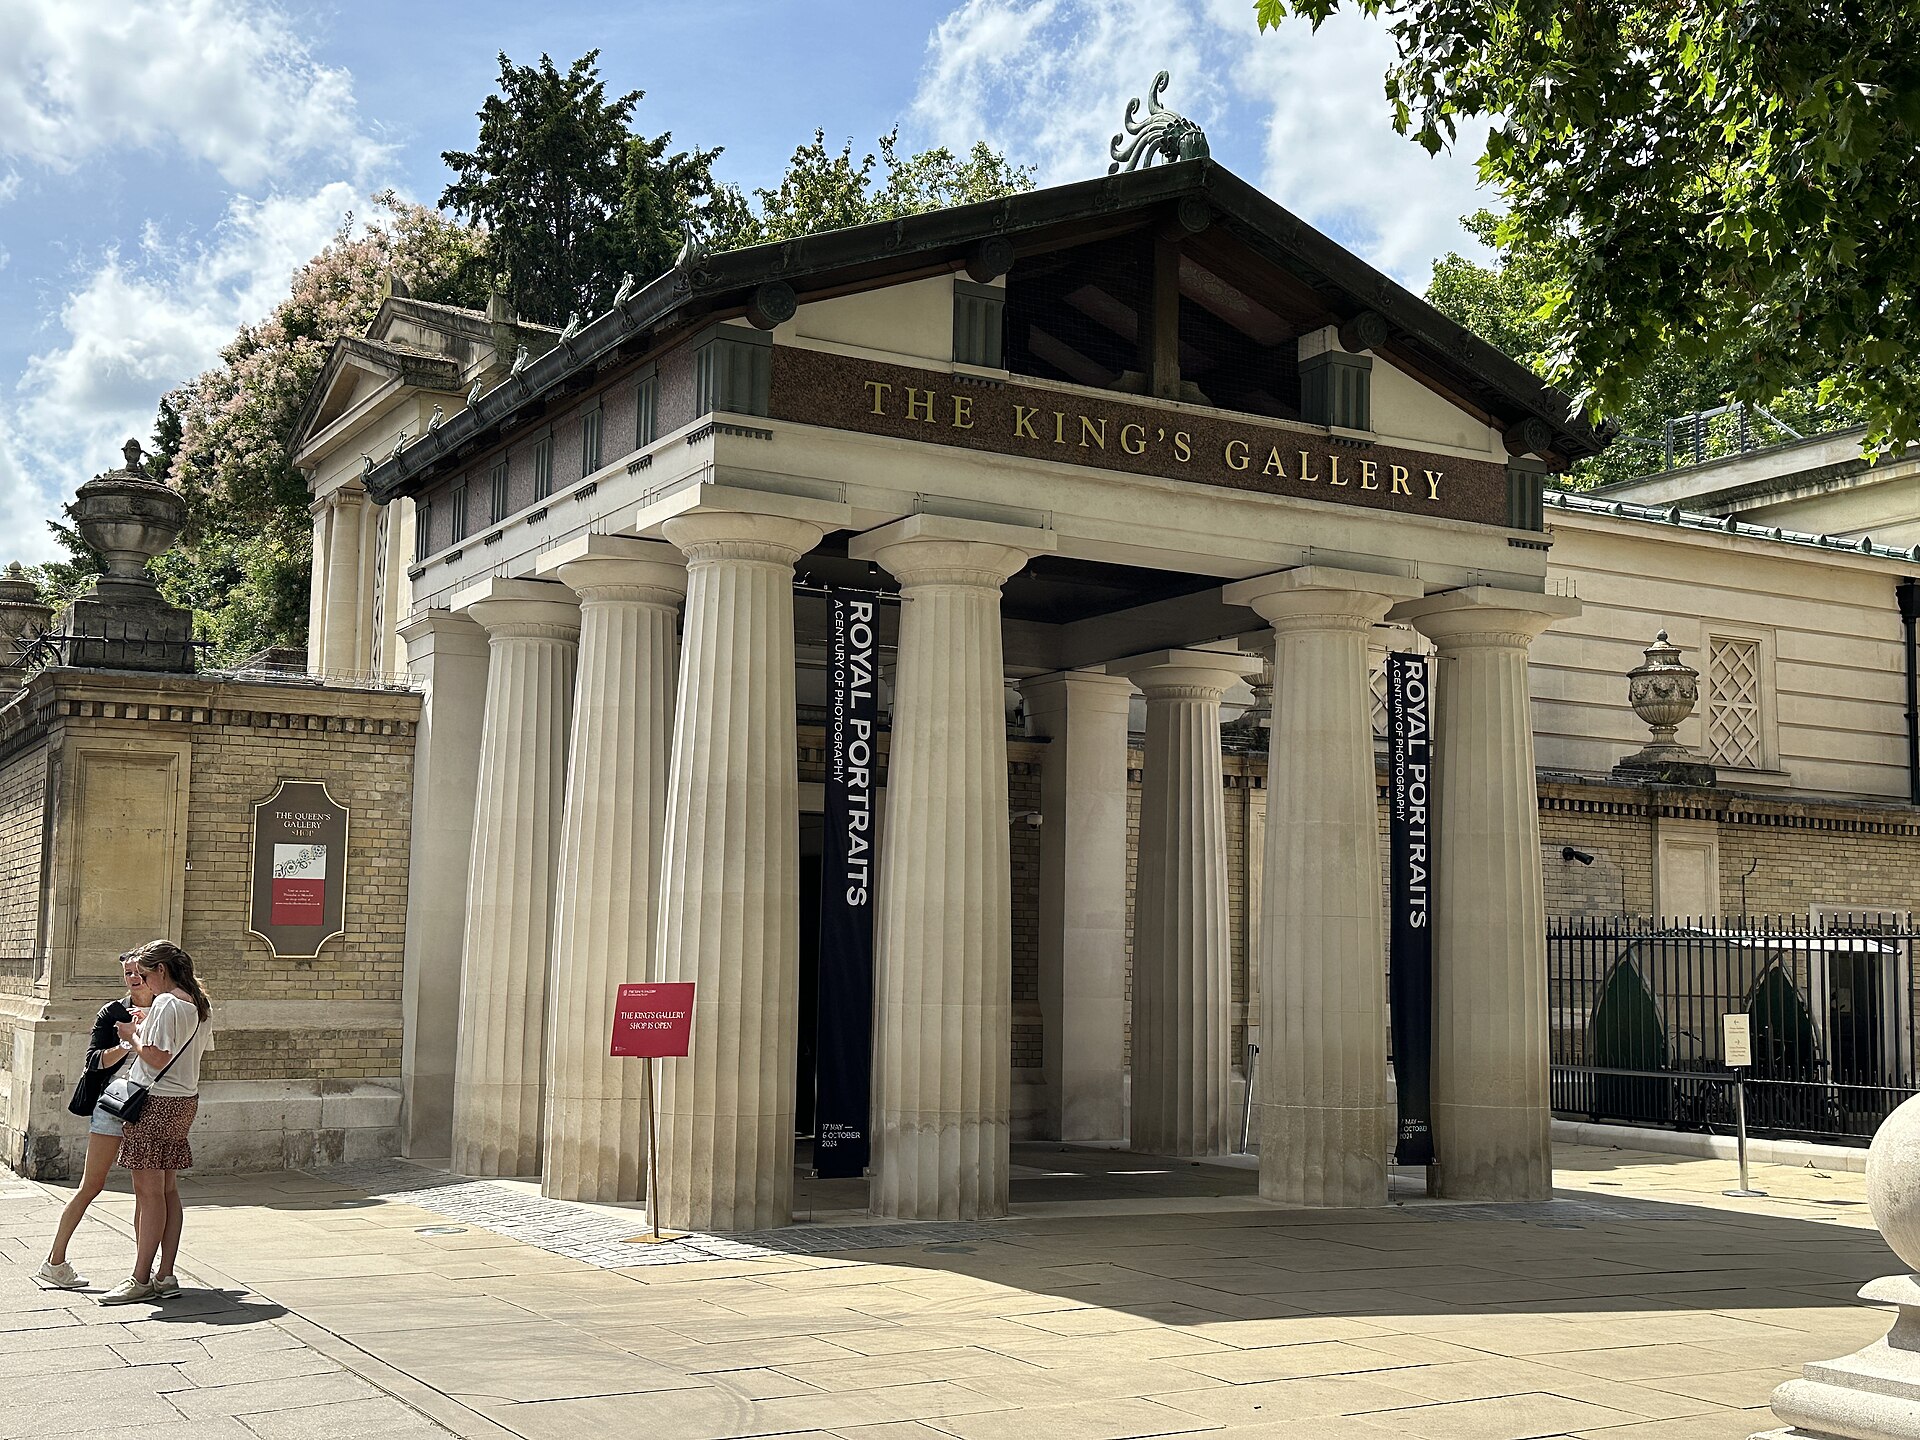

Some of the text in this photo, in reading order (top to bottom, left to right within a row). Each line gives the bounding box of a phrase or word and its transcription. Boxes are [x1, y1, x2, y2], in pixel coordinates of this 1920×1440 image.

[863, 380, 1445, 502] THE KING'S GALLERY
[833, 600, 845, 784] A CENTURY OF PHOTOGRAPHY
[1393, 660, 1405, 822] A CENTURY OF PHOTOGRAPHY
[846, 601, 873, 906] ROYAL PORTRAITS
[1404, 660, 1427, 928] ROYAL PORTRAITS
[276, 812, 331, 820] THE QUEEN'S
[284, 820, 322, 828] GALLERY
[621, 1012, 633, 1020] THE
[654, 1022, 672, 1030] OPEN
